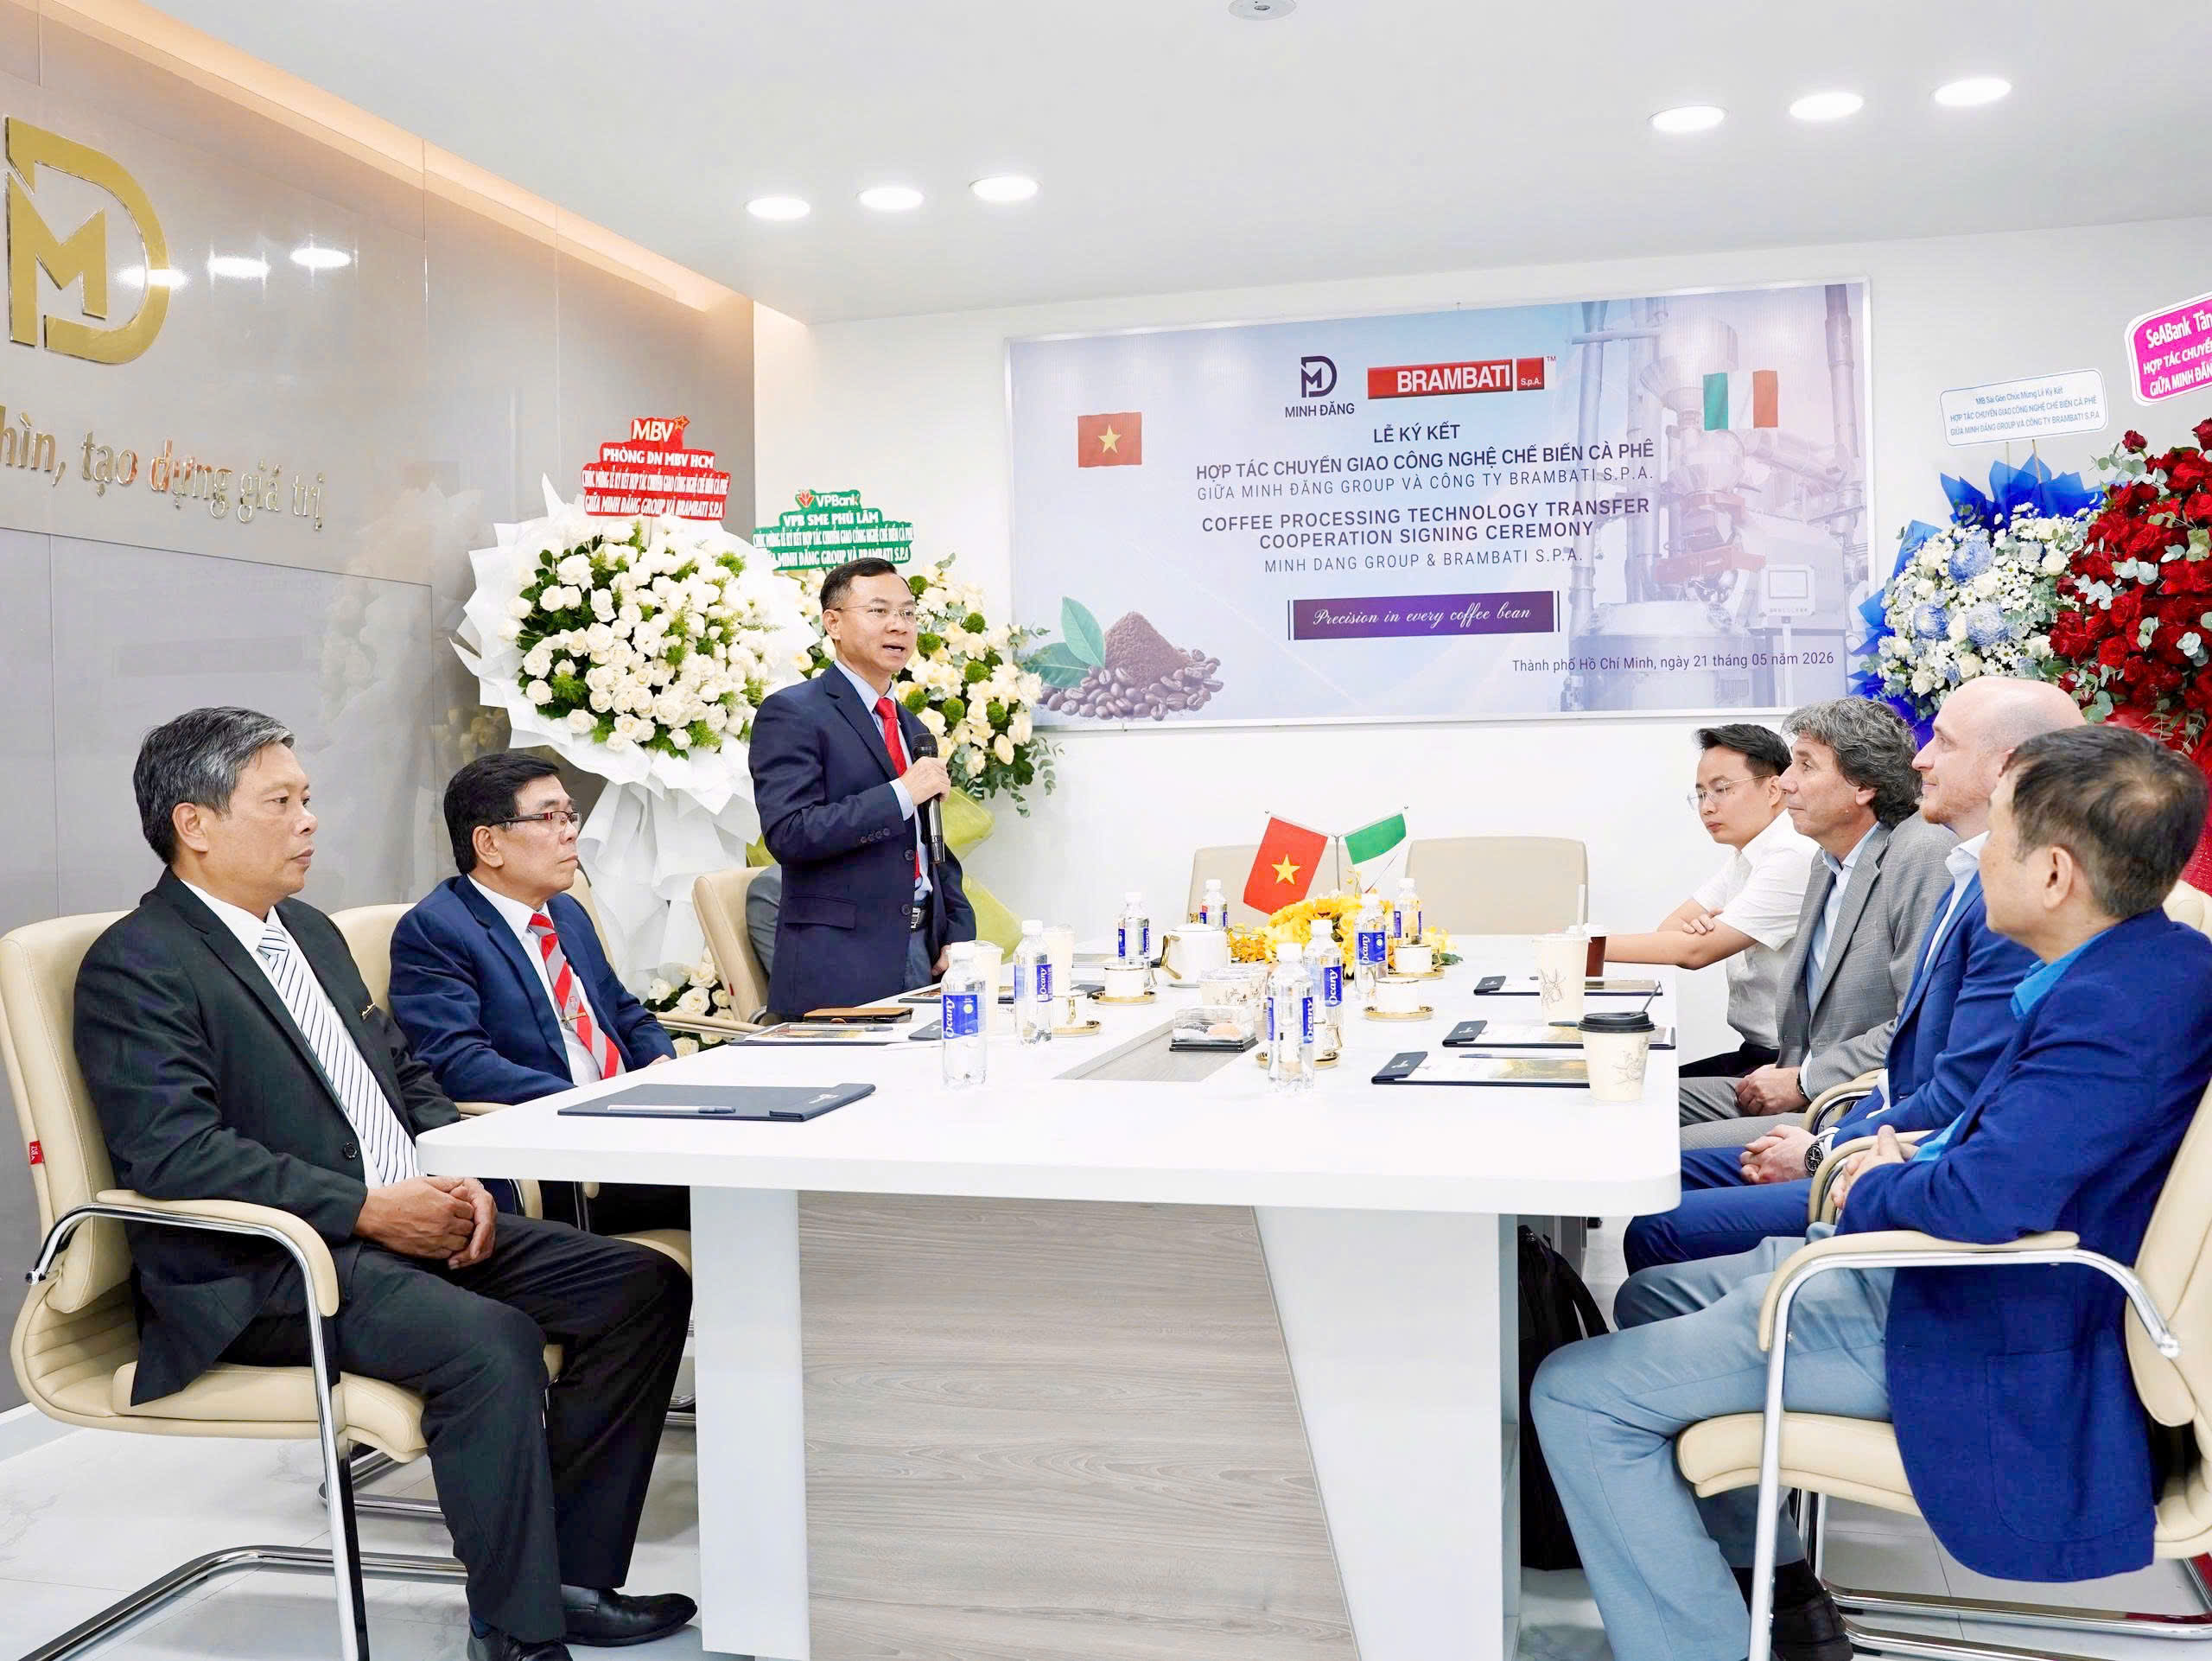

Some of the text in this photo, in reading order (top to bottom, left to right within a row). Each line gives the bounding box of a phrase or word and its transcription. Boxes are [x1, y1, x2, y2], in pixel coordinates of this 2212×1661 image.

[2145, 315, 2192, 349] SeABank
[2143, 336, 2212, 375] HỢP TÁC CHUYỂ
[1396, 364, 1541, 393] BRAMBATI S.p.A.
[2171, 368, 2195, 390] MINH
[1285, 400, 1355, 418] MINH ĐĂNG
[1996, 421, 2016, 430] GROUP
[2052, 412, 2084, 424] BRAMBATI
[632, 419, 675, 442] MBV
[1373, 421, 1460, 443] LỄ KÝ KẾT
[602, 446, 715, 469] PHÒNG DN MBV HCM
[1197, 438, 1654, 482] HỢP TÁC CHUYỂN GIAO CÔNG NGHỆ CHẾ BIẾN CÀ PHÊ
[80, 431, 138, 497] tạo
[149, 438, 233, 519] dựng
[237, 458, 283, 524] giá
[292, 472, 326, 532] trị
[1198, 466, 1654, 500] GIỮA MINH ĐĂNG GROUP VÀ CÔNG TY BRAMBATI S.P.A.
[816, 493, 860, 507] VPBank
[782, 514, 805, 527] VPB
[808, 512, 830, 525] SME
[831, 511, 855, 525] PHÚ
[1202, 498, 1649, 532] COFFEE PROCESSING TECHNOLOGY TRANSFER
[1260, 521, 1593, 550] COOPERATION SIGNING CEREMONY
[1265, 547, 1582, 573] MINH DANG GROUP & BRAMBATI S.P.A.
[1313, 601, 1532, 629] Precision in every coffee bean
[1512, 652, 1834, 674] Thành phố Hồ Chí Minh, ngày 21 tháng 05 năm 2026
[1362, 934, 1370, 964] Ocany
[1329, 968, 1338, 1005] Ocany
[945, 996, 955, 1038] Ocany
